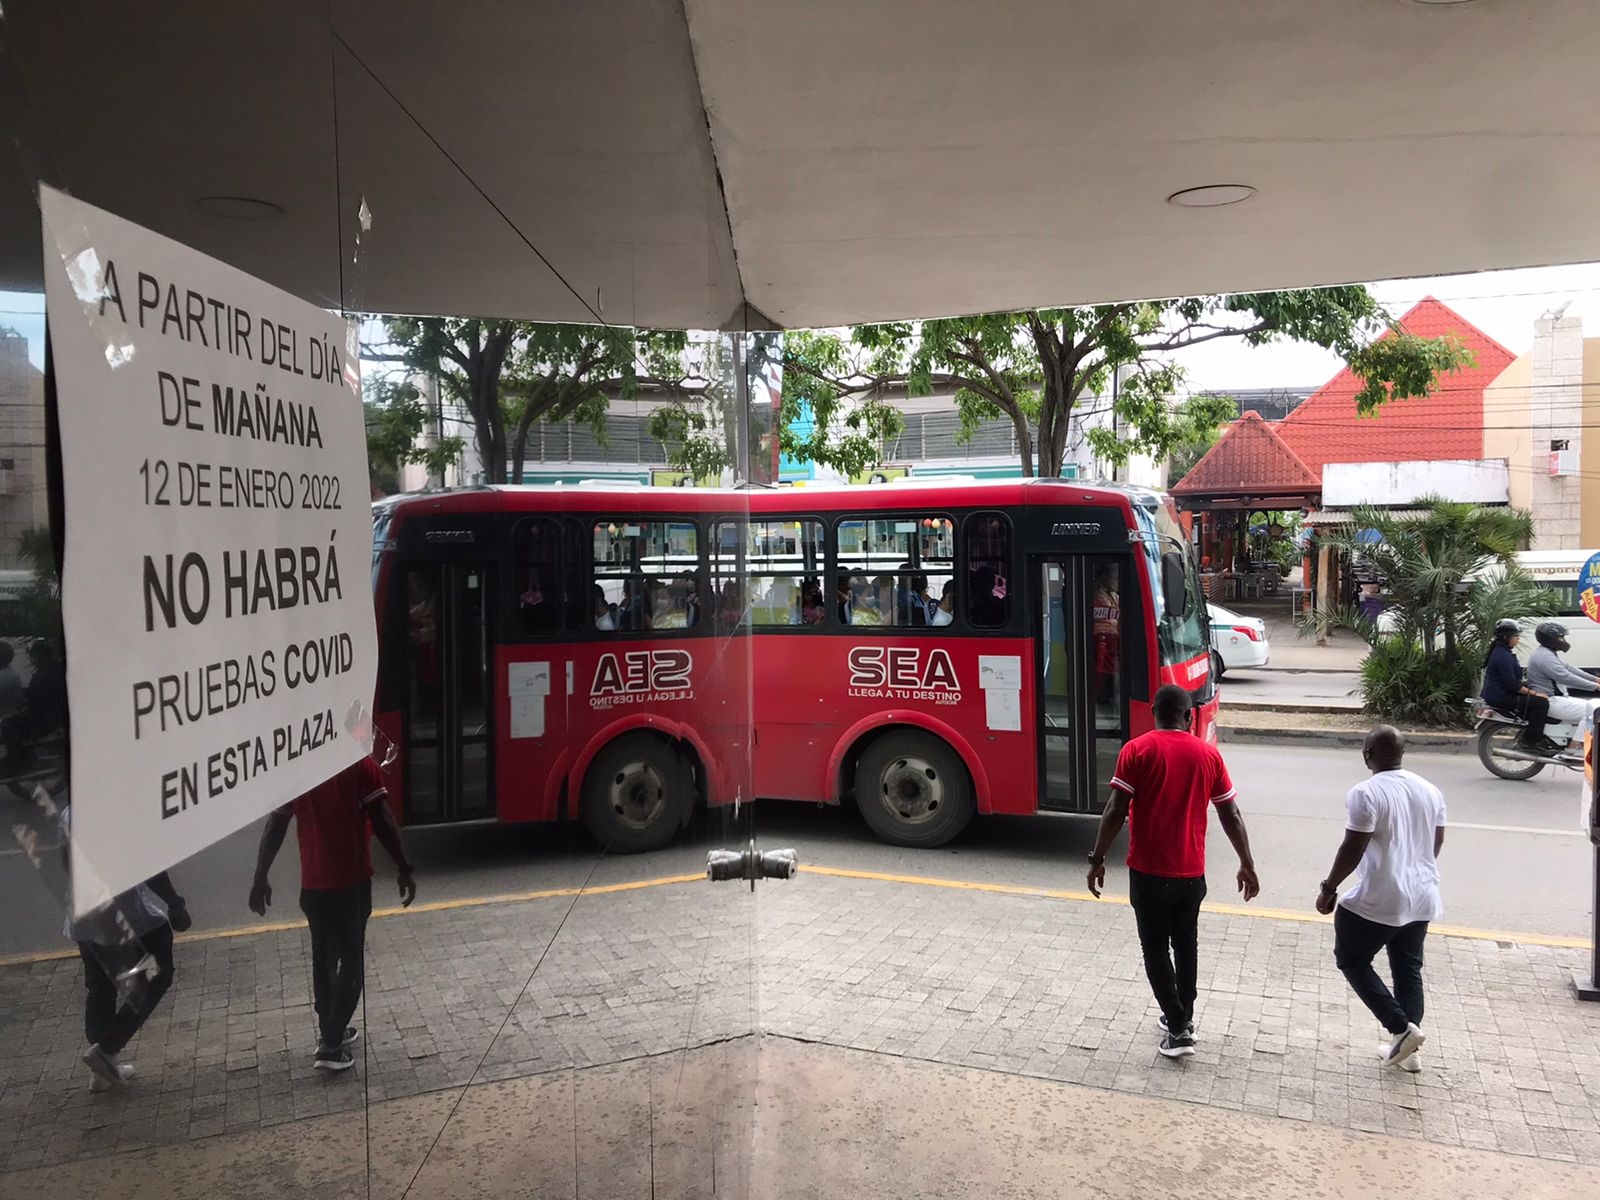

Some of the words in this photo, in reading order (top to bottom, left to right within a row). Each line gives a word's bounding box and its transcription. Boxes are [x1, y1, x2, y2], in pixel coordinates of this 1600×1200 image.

[98, 260, 127, 323] A
[138, 271, 253, 360] PARTIR
[260, 317, 304, 376] DEL
[309, 331, 344, 387] DÍA
[157, 370, 204, 431] DE
[211, 382, 323, 449] MAÑANA
[139, 458, 171, 506] 12
[178, 462, 212, 507] DE
[219, 465, 294, 510] ENERO
[300, 474, 342, 510] 2022
[142, 551, 210, 632] NO
[223, 529, 343, 619] HABRÁ
[132, 650, 276, 740] PRUEBAS
[283, 631, 354, 690] COVID
[848, 646, 961, 691] SEA
[848, 688, 884, 697] LLEGA
[885, 690, 894, 699] A
[897, 690, 910, 699] TU
[913, 691, 962, 702] DESTINO
[161, 762, 199, 821] EN
[207, 736, 268, 798] ESTA
[273, 708, 338, 767] PLAZA.
